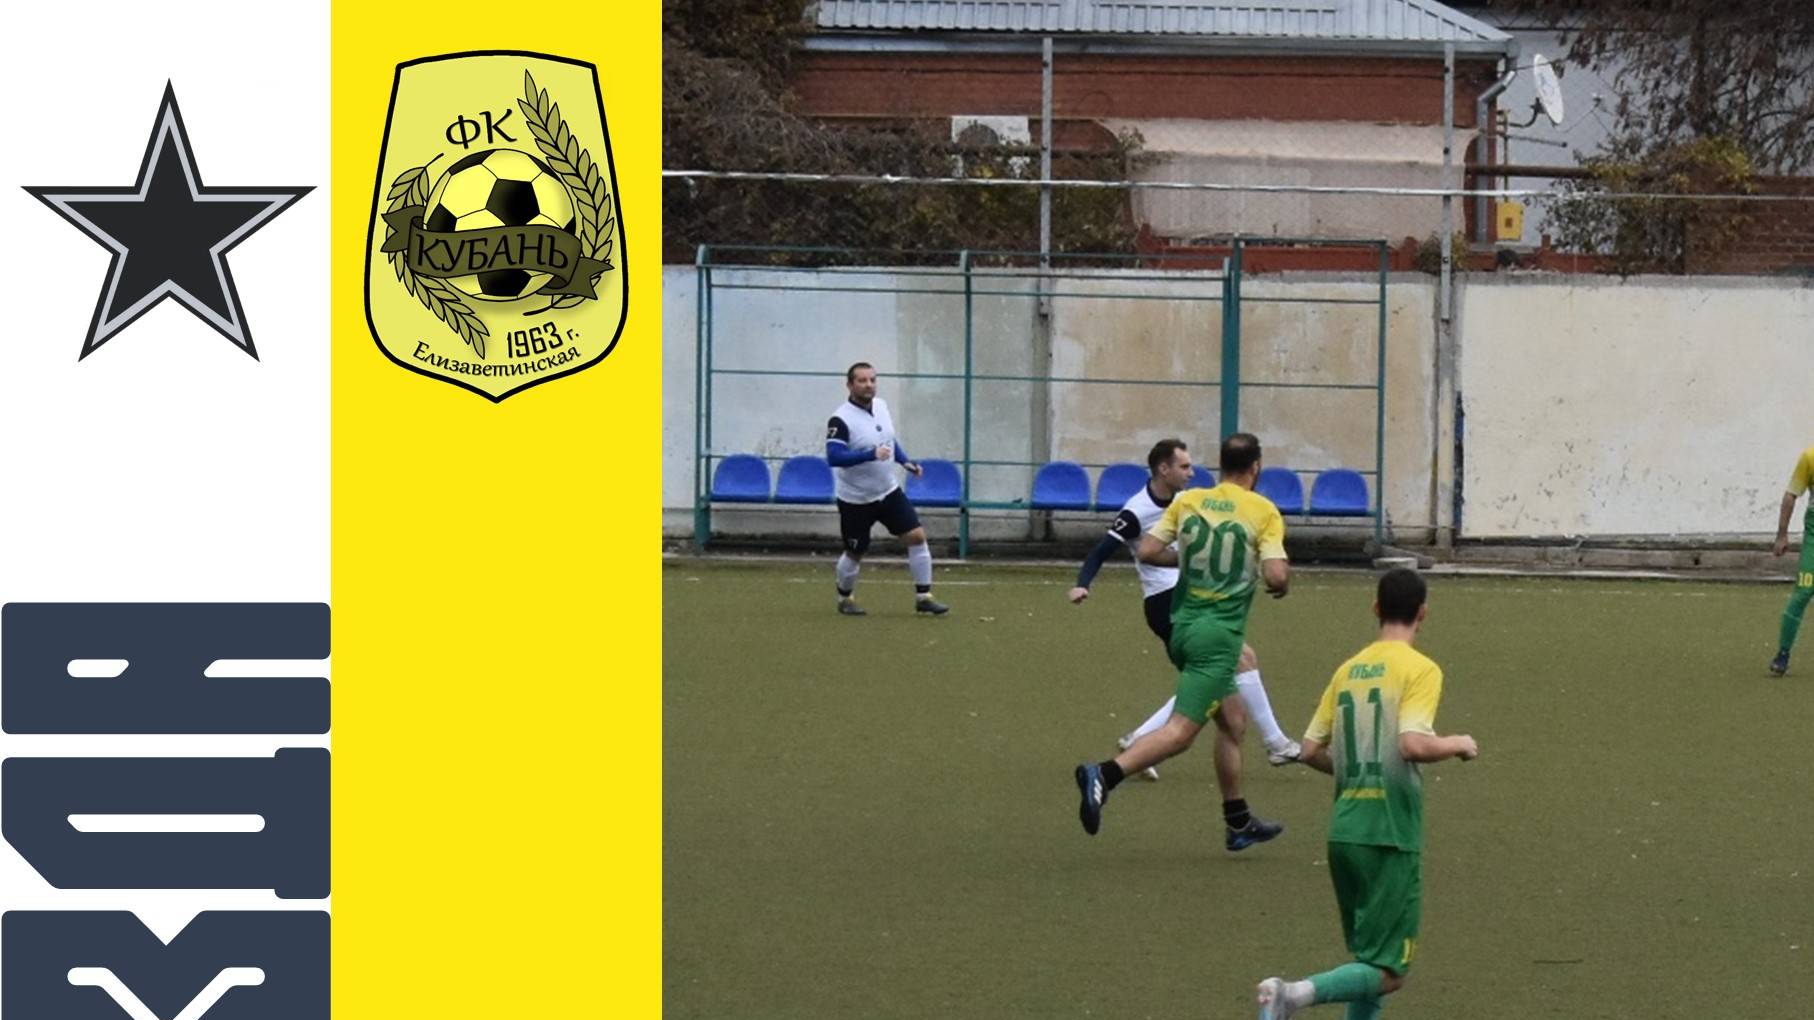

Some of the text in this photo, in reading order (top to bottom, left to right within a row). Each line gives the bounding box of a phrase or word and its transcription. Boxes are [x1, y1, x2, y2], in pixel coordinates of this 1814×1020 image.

[1181, 514, 1249, 582] 20
[1798, 572, 1814, 588] 10
[1338, 688, 1383, 778] 11
